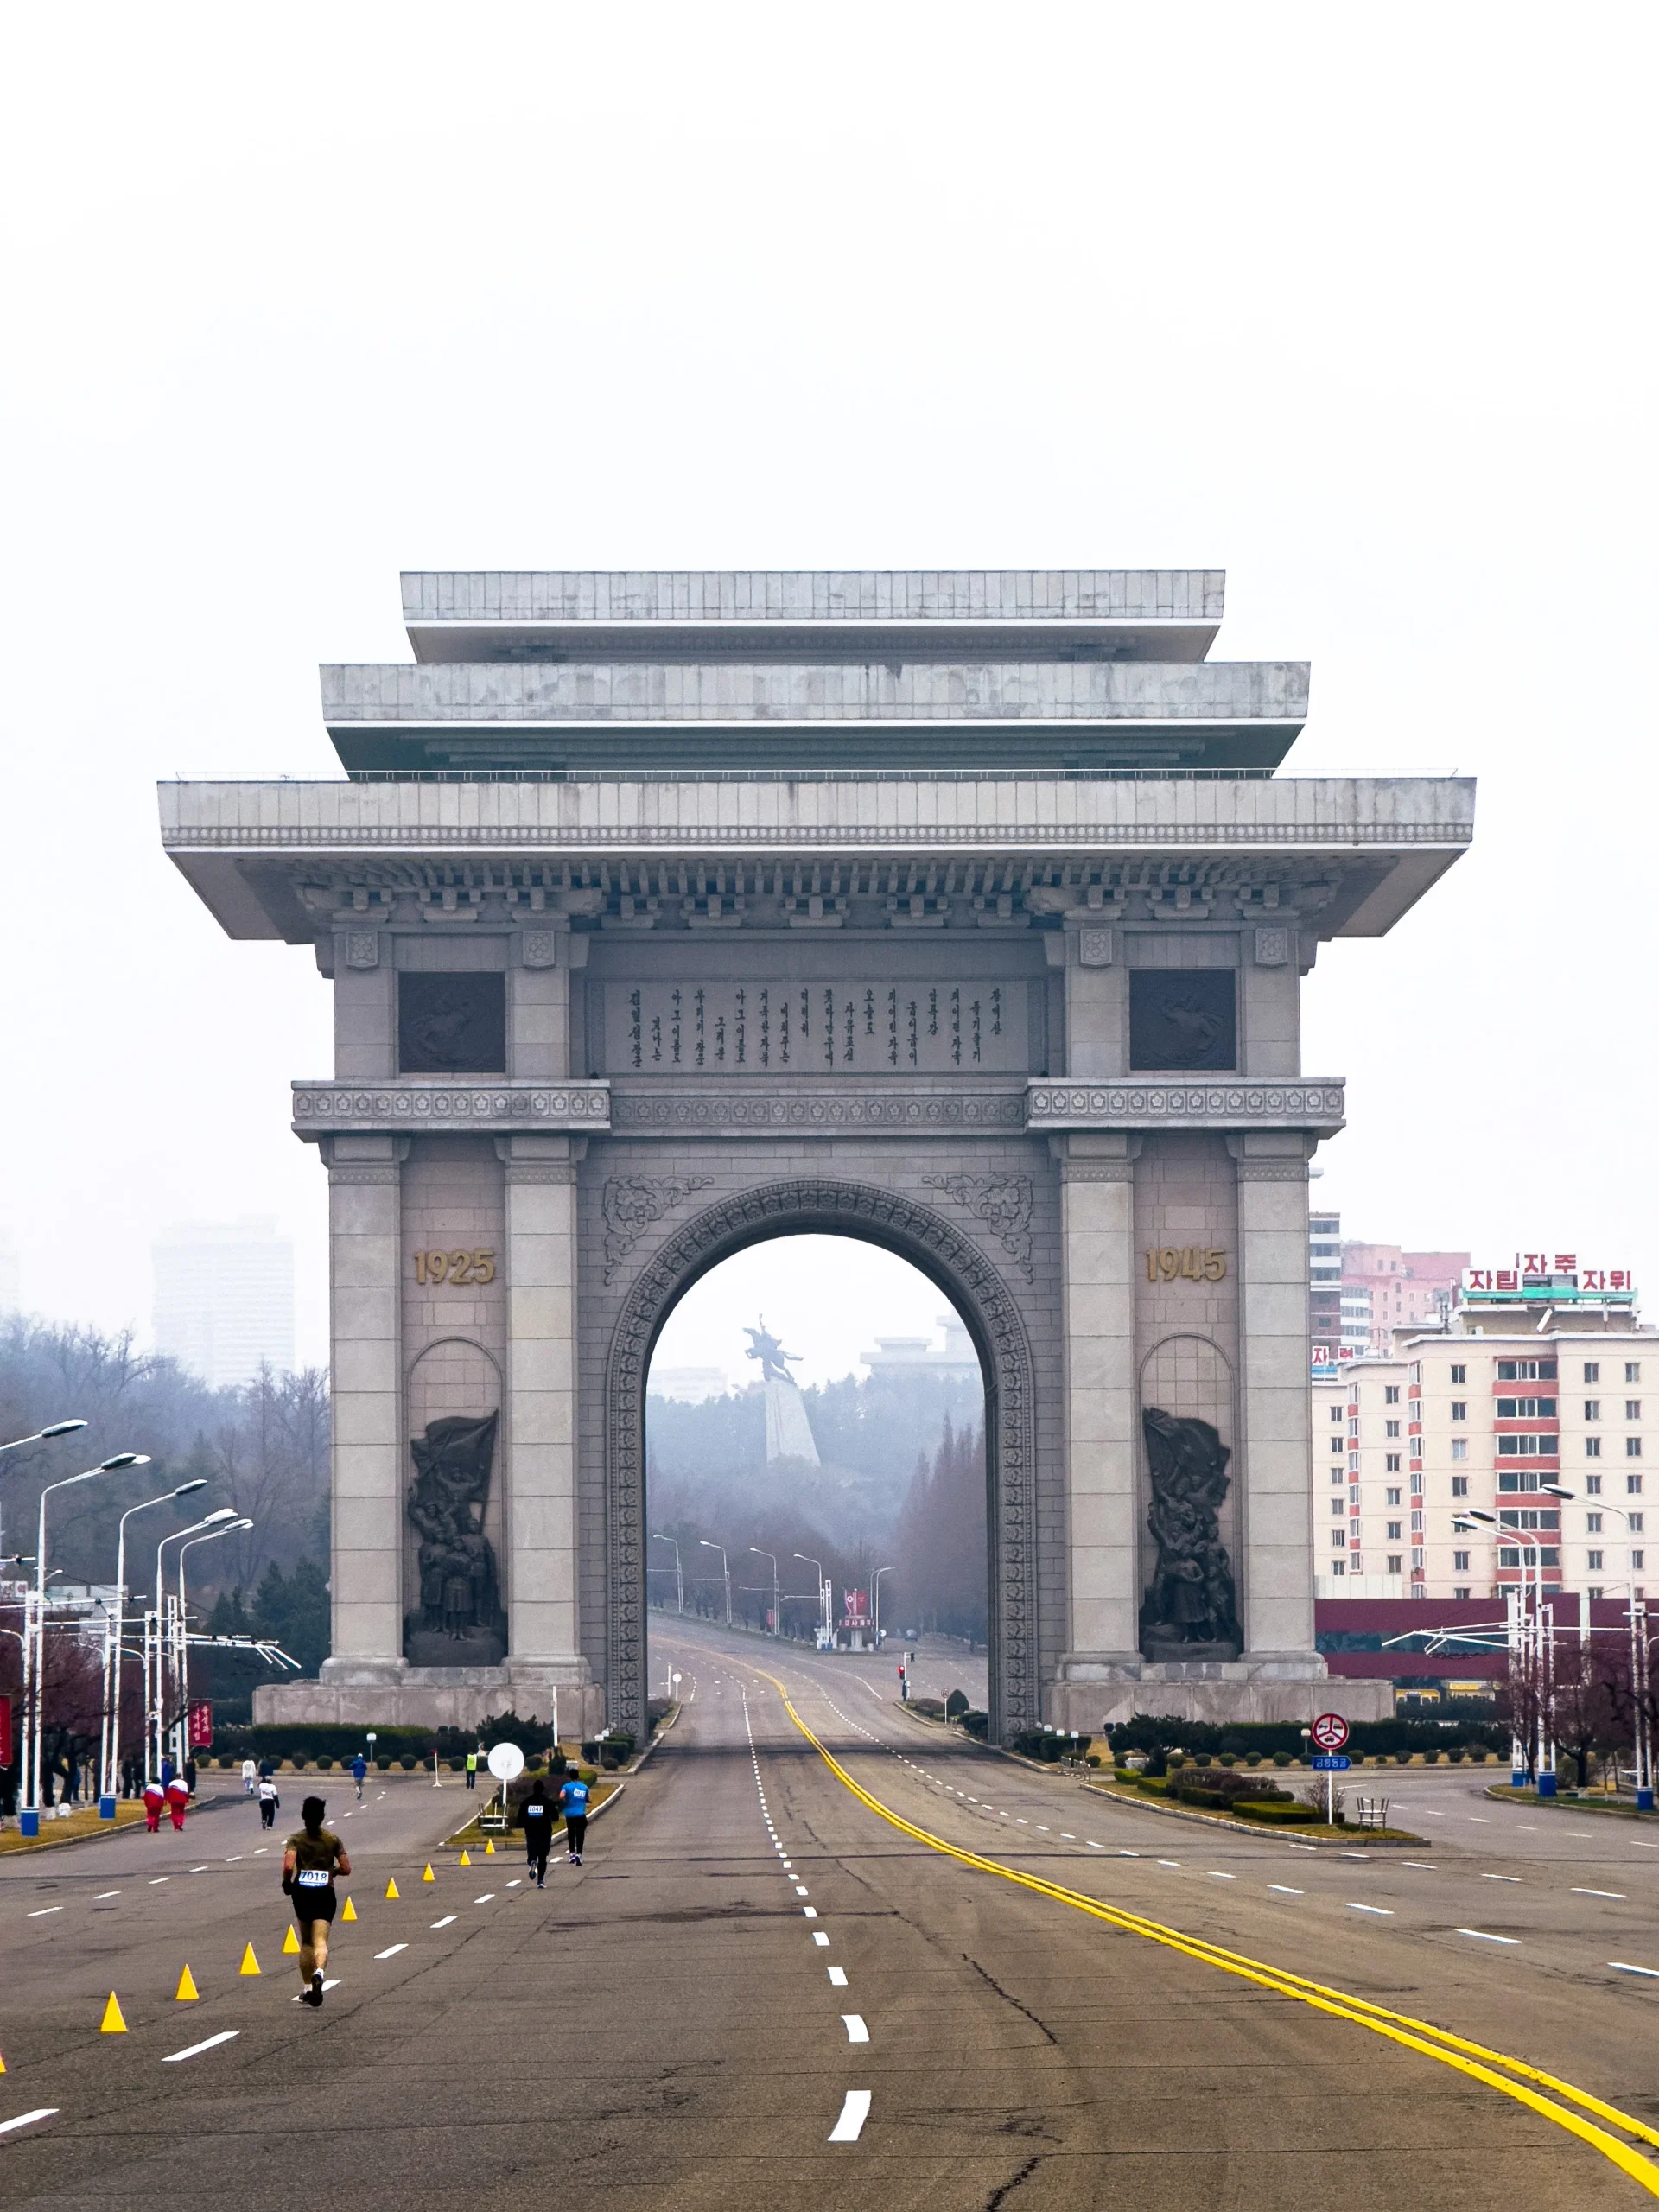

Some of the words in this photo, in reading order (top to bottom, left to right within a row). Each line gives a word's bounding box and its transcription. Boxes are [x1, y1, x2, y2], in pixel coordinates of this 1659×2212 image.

[415, 1249, 494, 1284] 1925
[1147, 1247, 1226, 1281] 1945
[1524, 1254, 1576, 1274] 자주
[1469, 1270, 1518, 1290] 자립
[1583, 1270, 1631, 1290] 자위
[301, 1872, 327, 1882] 7018
